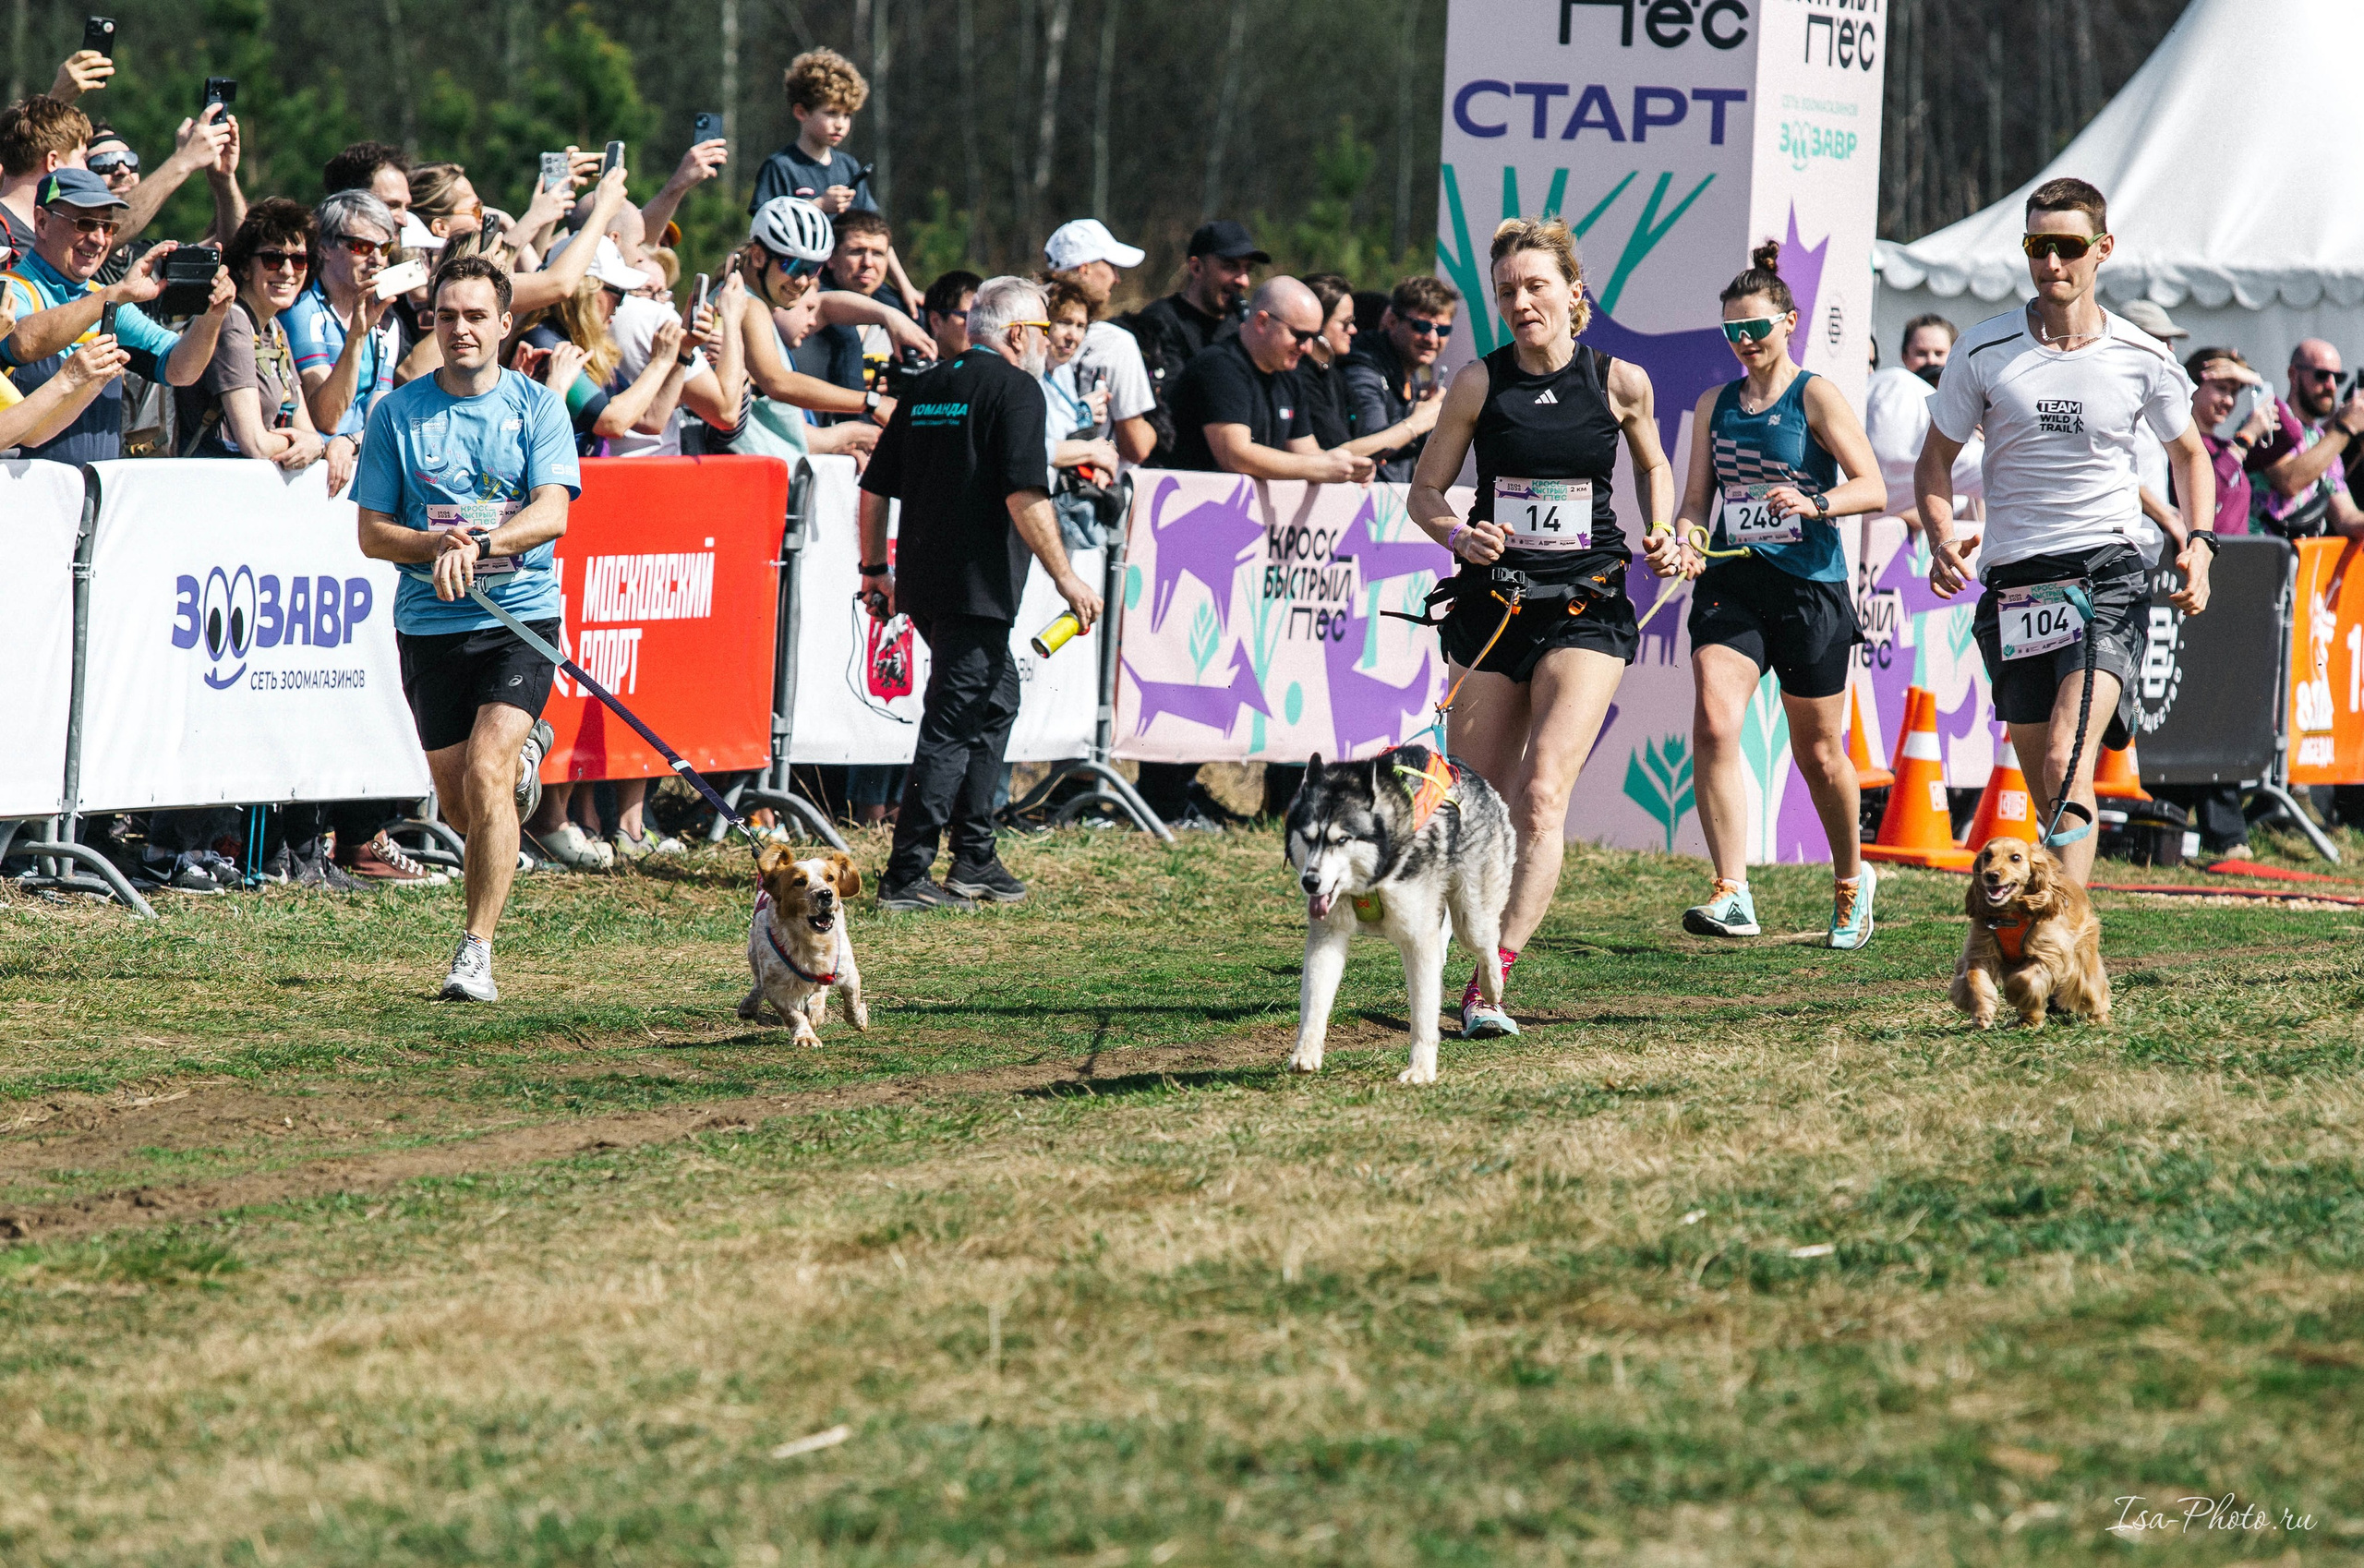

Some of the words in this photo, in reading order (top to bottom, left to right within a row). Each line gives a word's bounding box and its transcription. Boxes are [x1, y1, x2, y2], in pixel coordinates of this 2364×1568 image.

[1453, 79, 1748, 145] СТАРТ
[911, 403, 969, 416] КОМАНДА
[2039, 401, 2081, 414] TEAM
[2040, 415, 2070, 424] WILD
[2039, 424, 2073, 434] TRAIL
[1526, 505, 1562, 532] 14
[1269, 525, 1338, 561] КРОСС
[582, 537, 715, 623] МОСКОВСКИЙ
[1264, 556, 1352, 601] БЫСТРЫЙ
[2031, 583, 2059, 592] КРОСС
[172, 564, 373, 662] ЗООЗАВР
[2020, 606, 2069, 639] 104
[576, 628, 643, 697] СПОРТ
[250, 671, 278, 691] СЕТЬ
[280, 669, 366, 690] ЗООМАГАЗИНОВ
